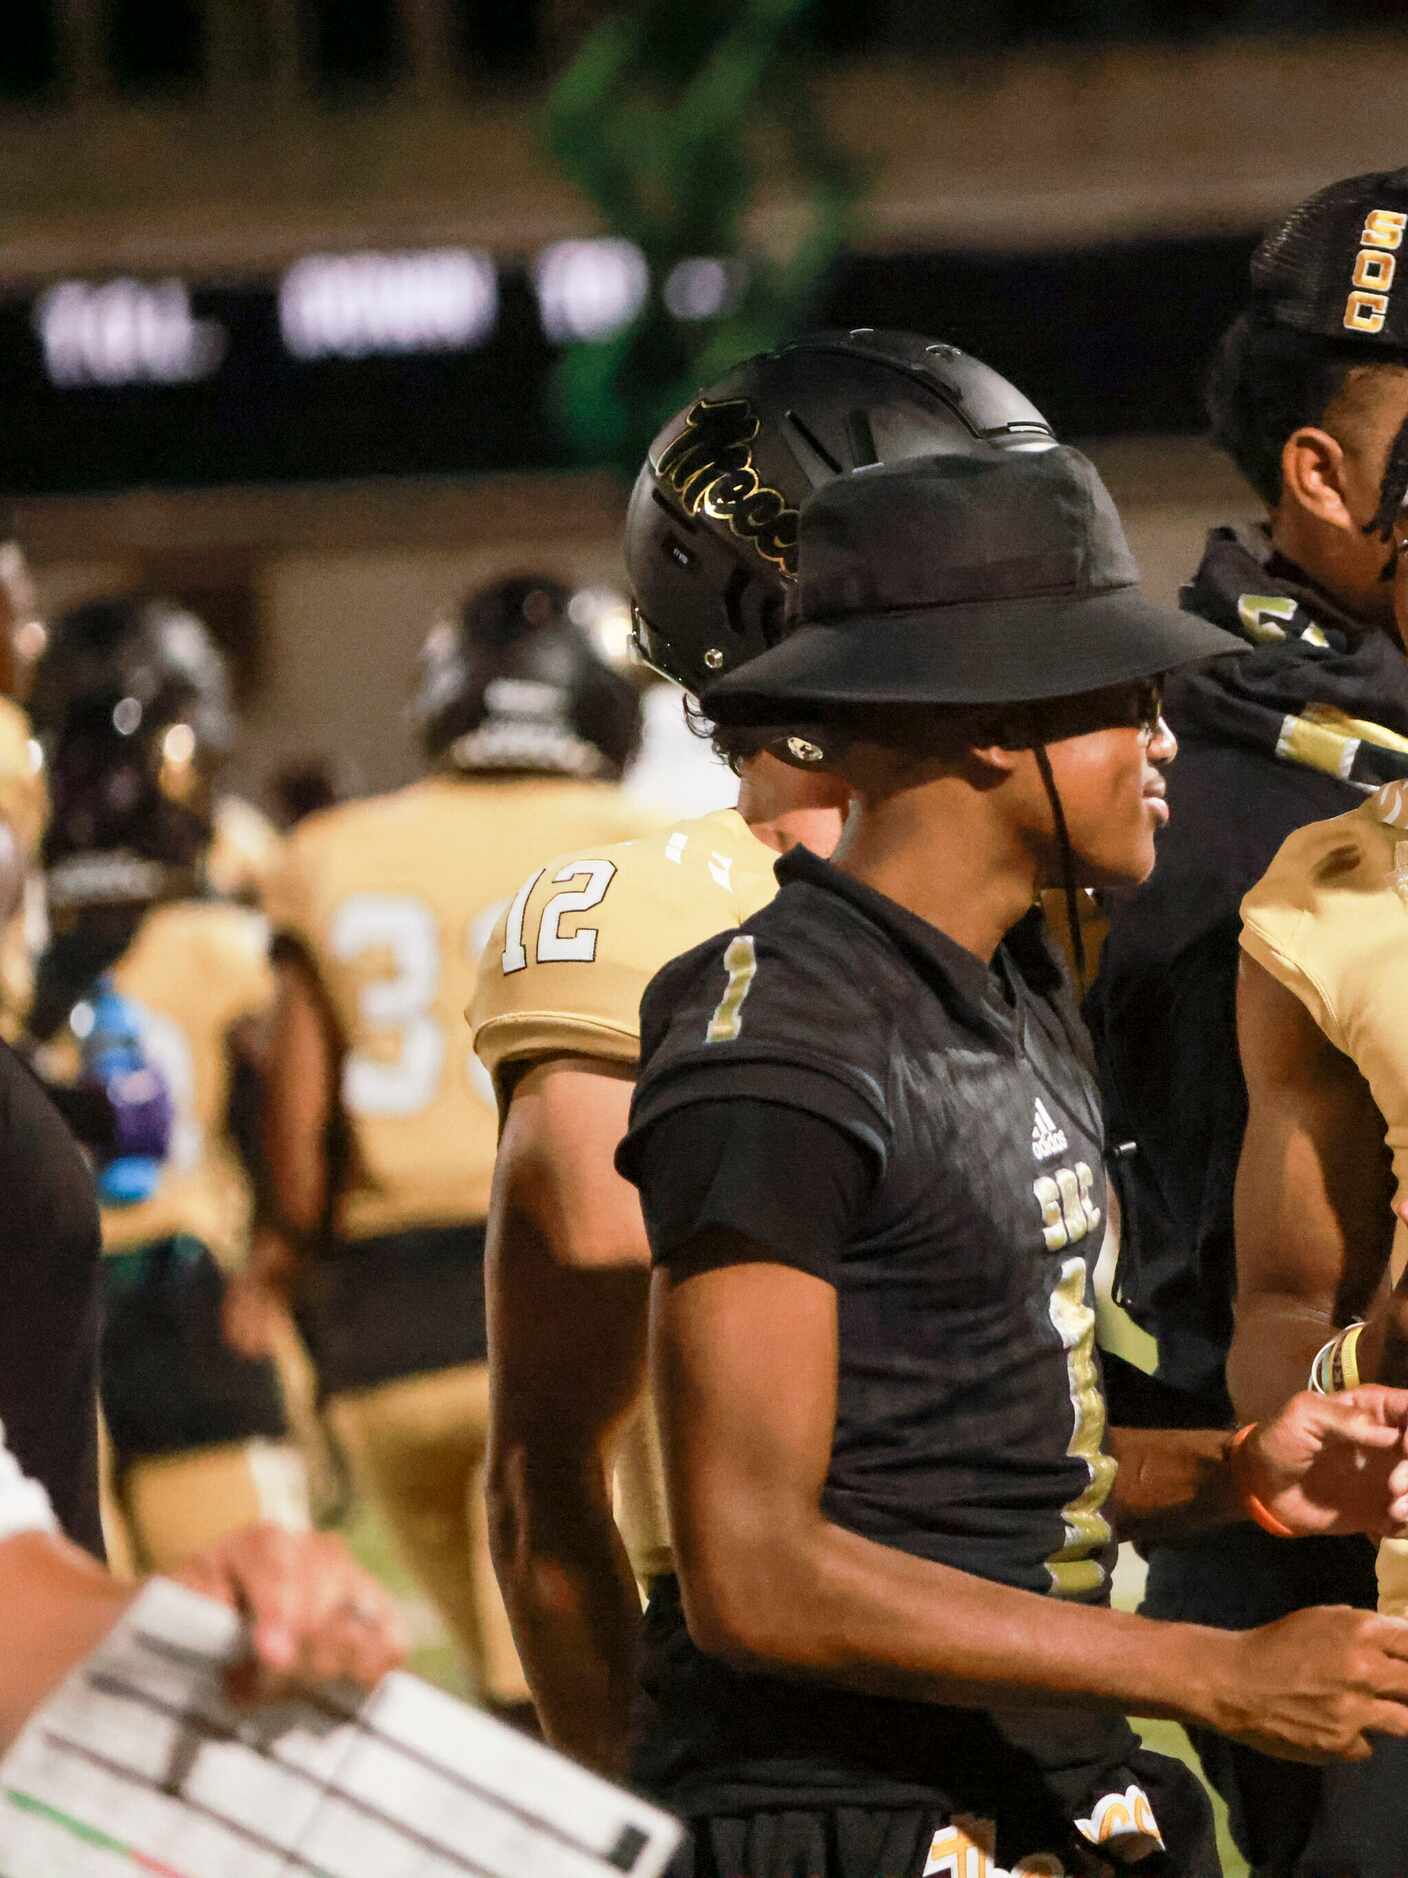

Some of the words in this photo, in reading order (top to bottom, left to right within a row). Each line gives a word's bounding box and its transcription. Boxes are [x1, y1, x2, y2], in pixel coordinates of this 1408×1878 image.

[1343, 208, 1408, 334] SOC
[502, 858, 618, 976] 12
[705, 935, 757, 1043] 1
[1033, 1161, 1101, 1251] SOC
